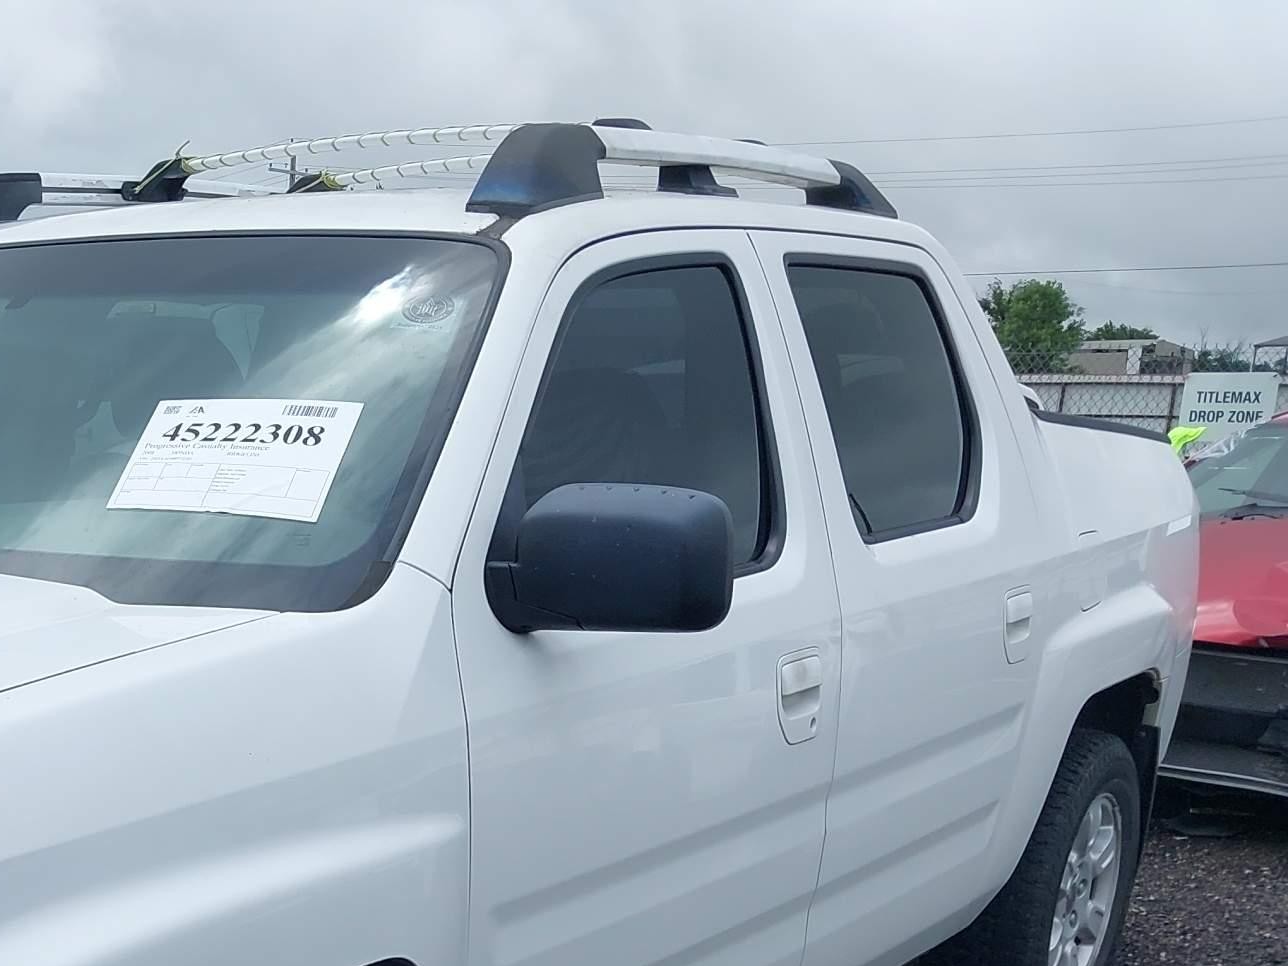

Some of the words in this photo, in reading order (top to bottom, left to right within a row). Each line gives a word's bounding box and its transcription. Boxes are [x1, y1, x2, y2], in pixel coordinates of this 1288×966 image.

[1197, 391, 1261, 404] TITLEMAX
[1189, 410, 1224, 423] DROP
[162, 422, 326, 447] 45222308
